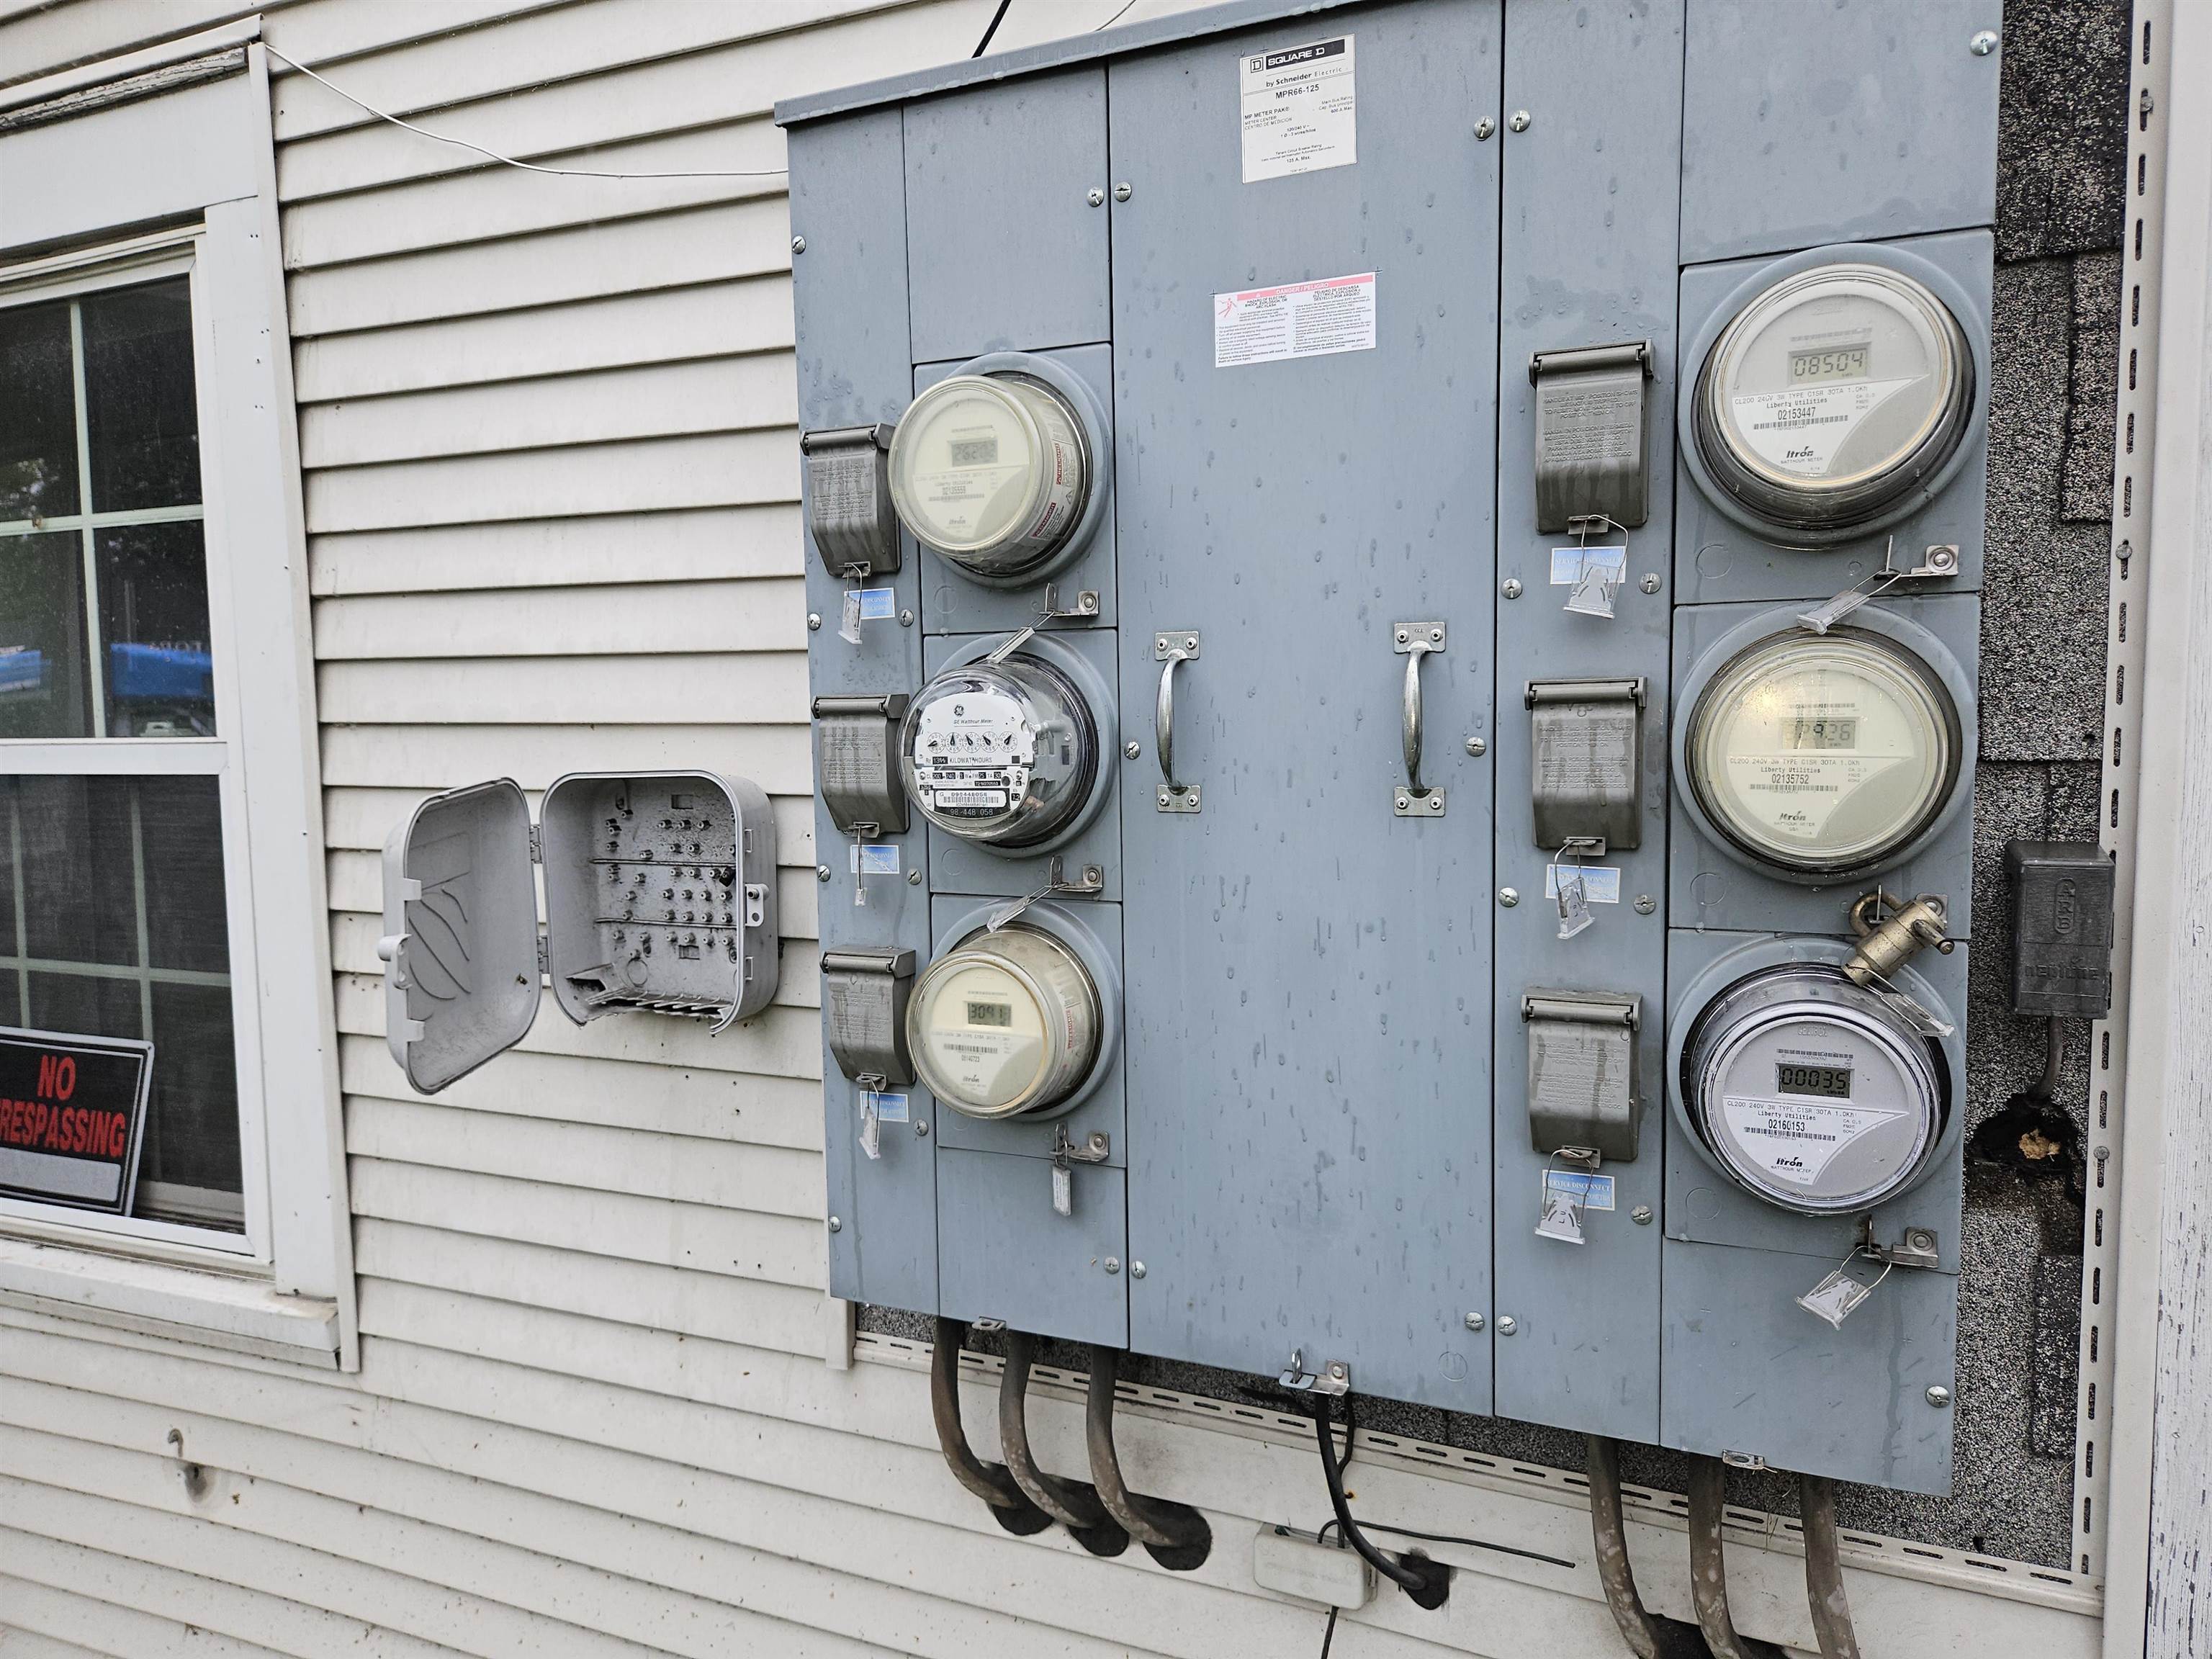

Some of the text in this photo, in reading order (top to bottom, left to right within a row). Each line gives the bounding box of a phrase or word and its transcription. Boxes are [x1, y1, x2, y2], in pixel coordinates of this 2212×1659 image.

[1267, 50, 1313, 66] SQUARE
[1316, 47, 1325, 56] D
[1276, 73, 1311, 85] Schneider
[1314, 66, 1341, 77] Electric
[1275, 84, 1319, 99] MPR66-125
[1254, 109, 1273, 118] METER
[1794, 352, 1863, 377] 08504
[1778, 407, 1816, 421] 02153447
[1786, 446, 1814, 458] Itron
[1771, 773, 1809, 784] 02135752
[38, 1054, 76, 1101] NO
[1781, 1068, 1847, 1089] 00035
[1785, 1112, 1816, 1121] Utilities
[0, 1098, 126, 1158] RESPASSING
[1768, 1119, 1805, 1132] 02160153
[1776, 1156, 1803, 1167] Itron
